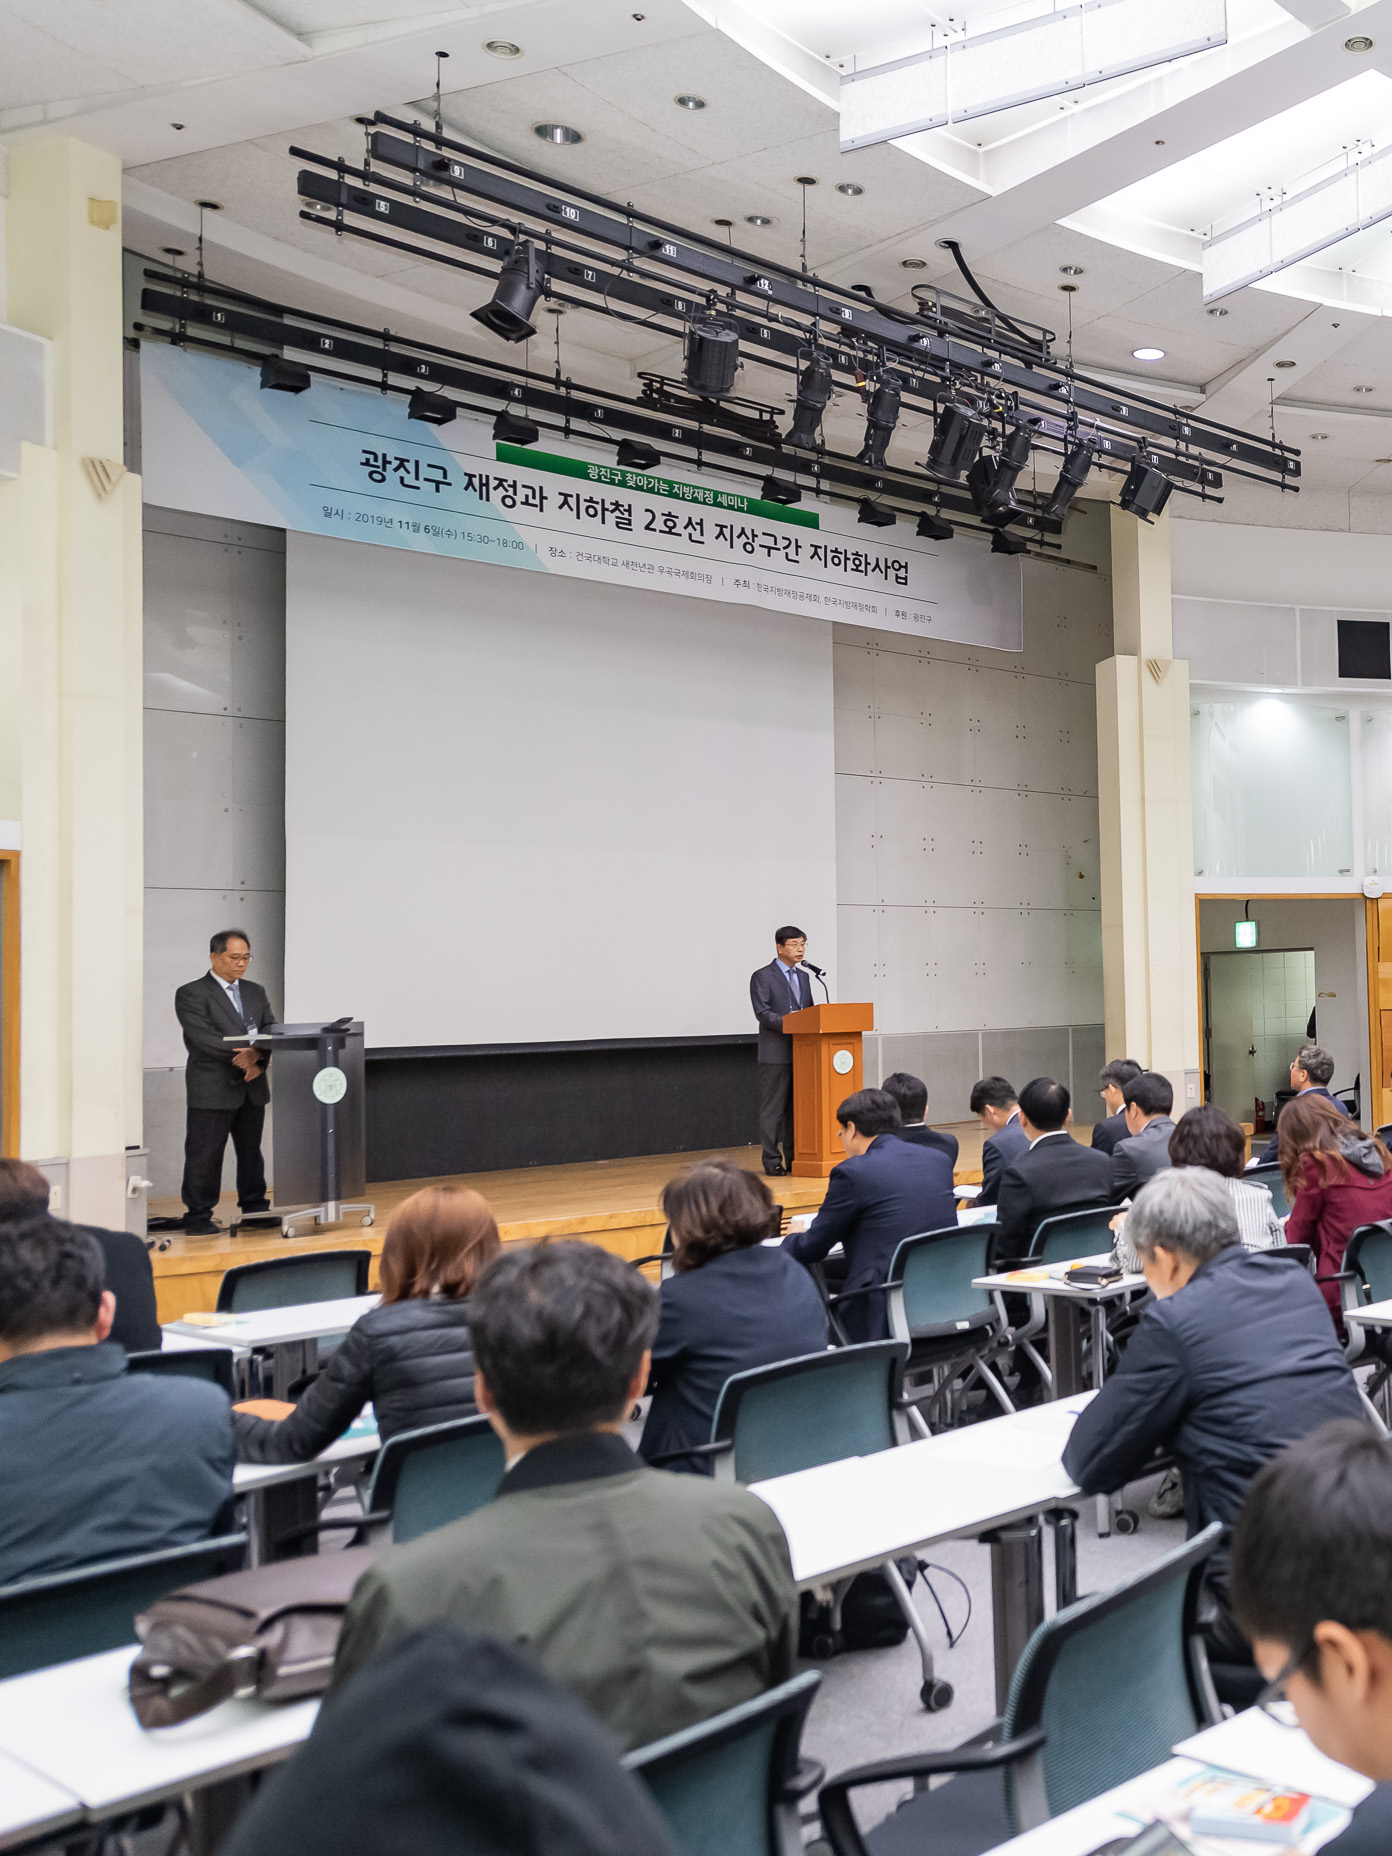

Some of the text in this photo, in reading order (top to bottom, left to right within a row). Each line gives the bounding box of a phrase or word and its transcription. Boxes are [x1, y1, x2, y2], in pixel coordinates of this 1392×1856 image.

[360, 449, 909, 586] 광진구 재정과 지하철 2호선 지상구간 지하화사업
[587, 465, 748, 511] 광진구 찾아가는 지방재정 세미나
[322, 506, 344, 520] 일시
[355, 512, 394, 529] 2019년
[398, 520, 421, 534] 11월
[424, 524, 457, 540] 6일(수)
[461, 531, 525, 551] 15:30~18:00
[549, 546, 567, 559] 장소
[575, 551, 619, 568] 건국대학교
[621, 559, 655, 575] 새천년관
[657, 565, 713, 585] 우곡국제회의장
[733, 578, 750, 590] 주최
[824, 595, 878, 615] 한국지방재정학회
[894, 609, 907, 620] 후원
[913, 613, 933, 624] 광진구
